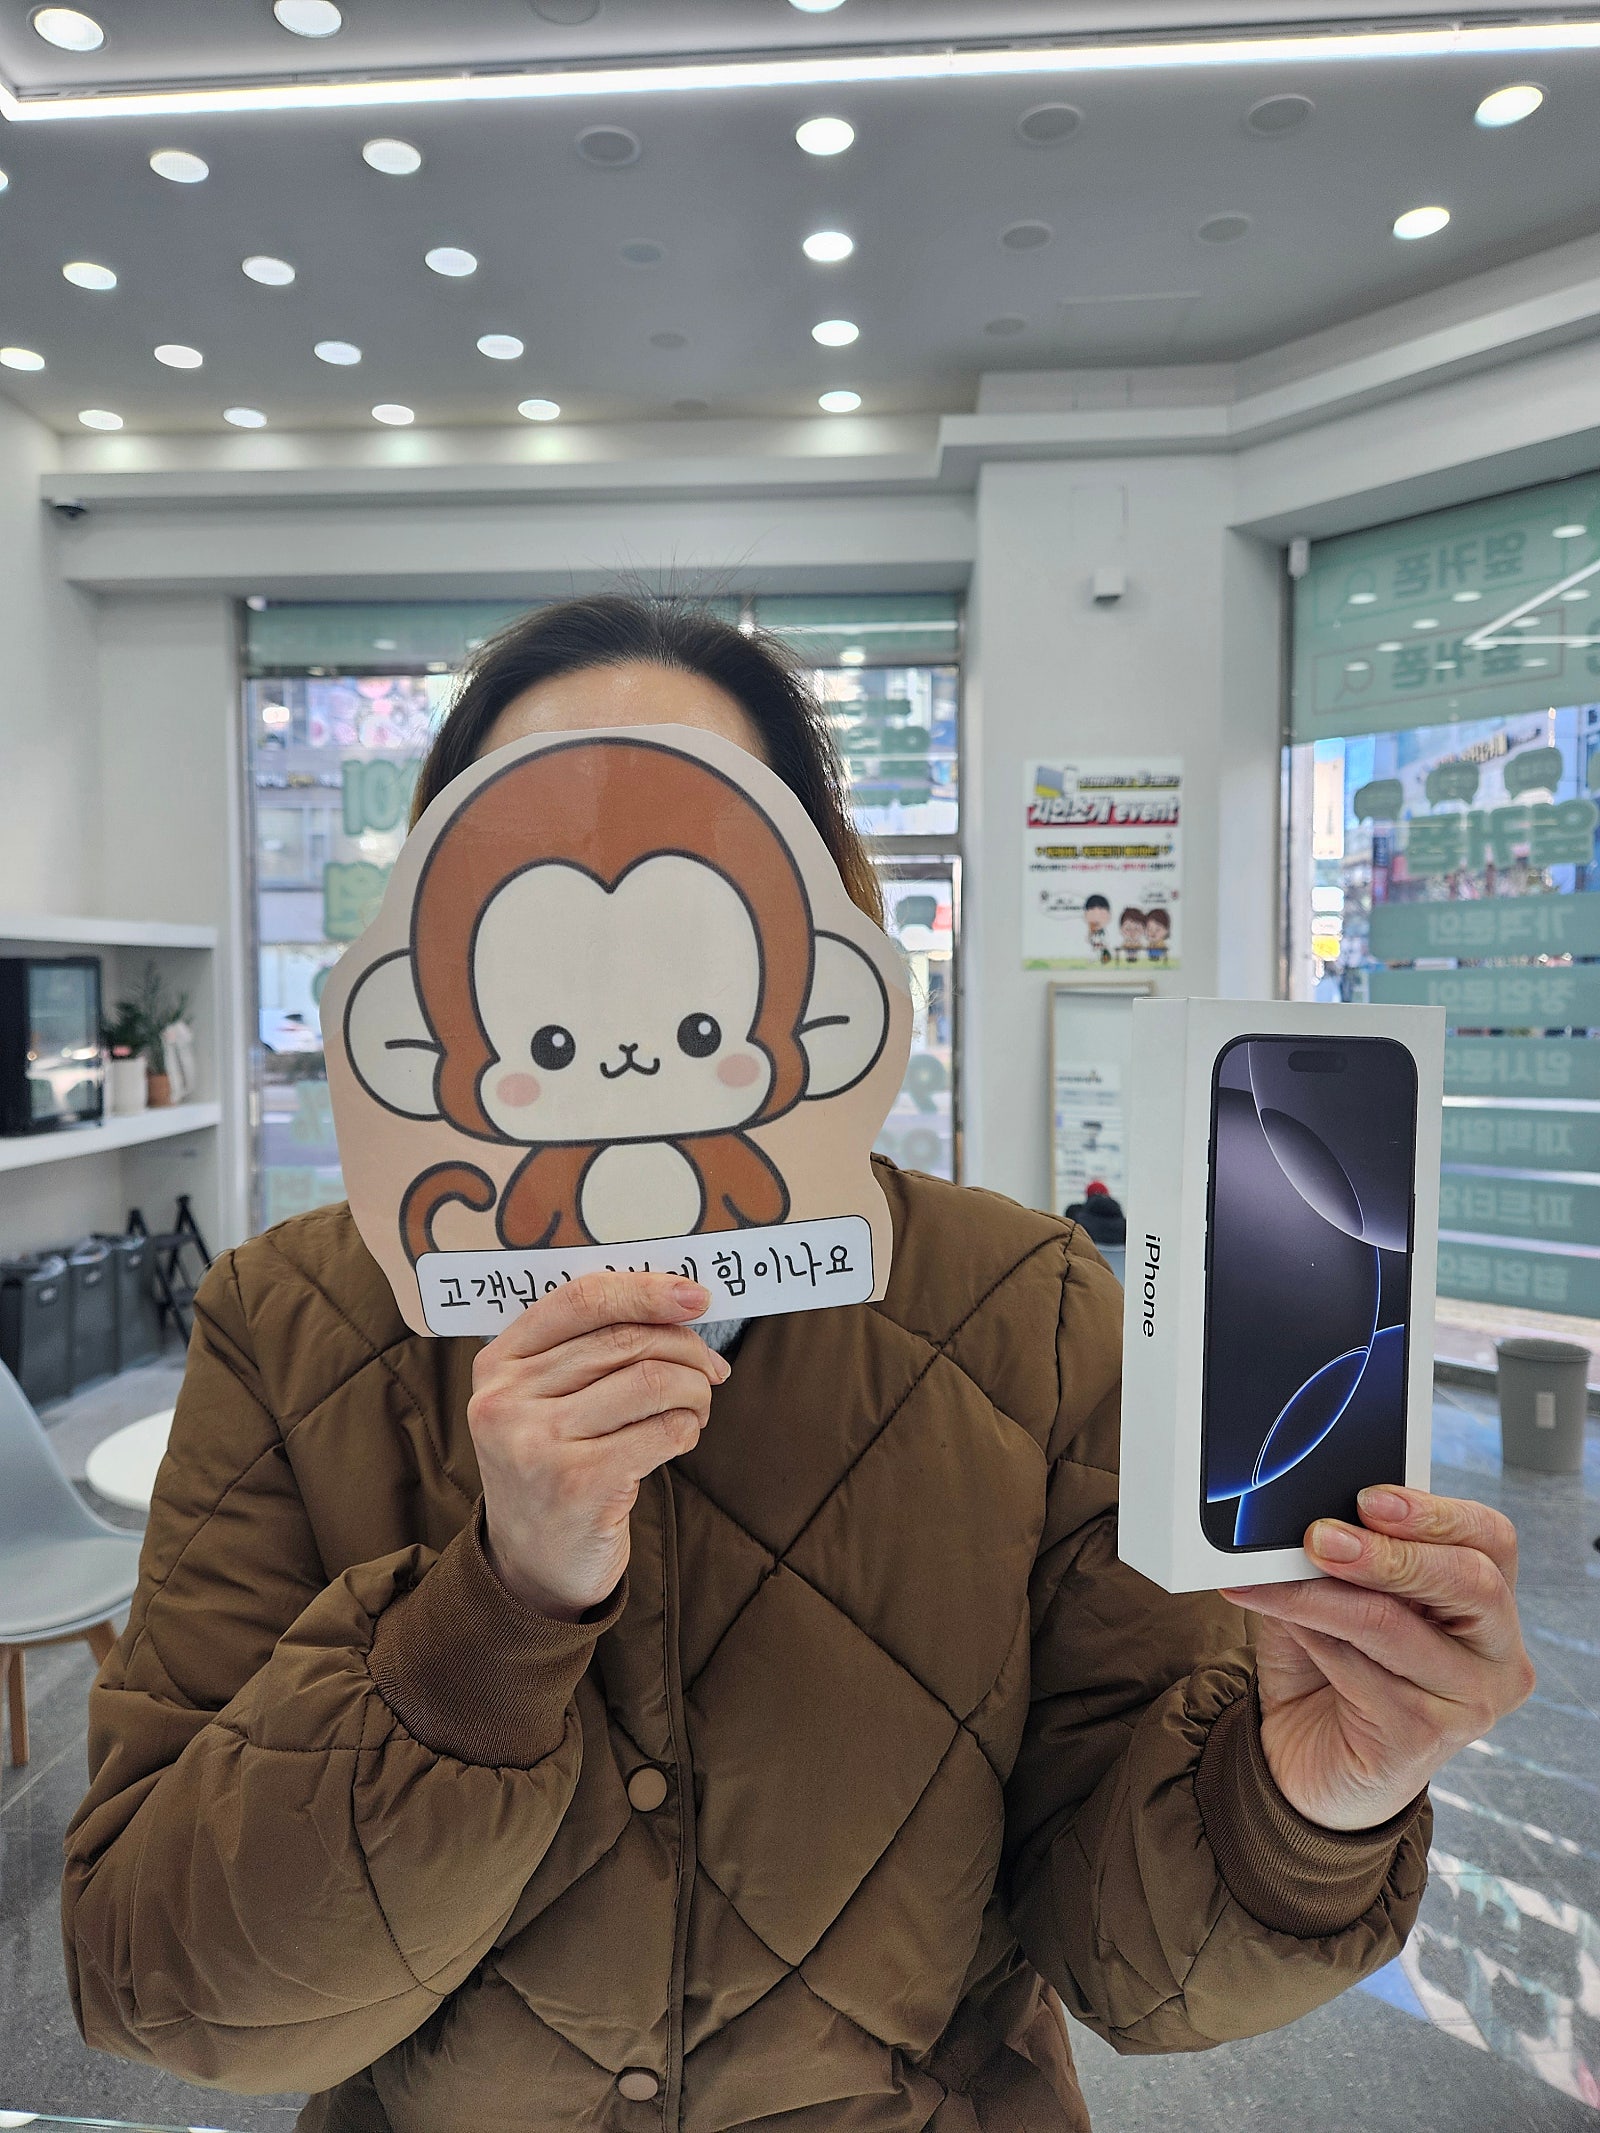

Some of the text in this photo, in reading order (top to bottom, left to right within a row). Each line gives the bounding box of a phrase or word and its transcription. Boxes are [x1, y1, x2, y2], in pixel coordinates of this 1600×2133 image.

[1114, 797, 1180, 823] event
[712, 1242, 854, 1296] 힘이나요
[1143, 1234, 1161, 1337] iPhone
